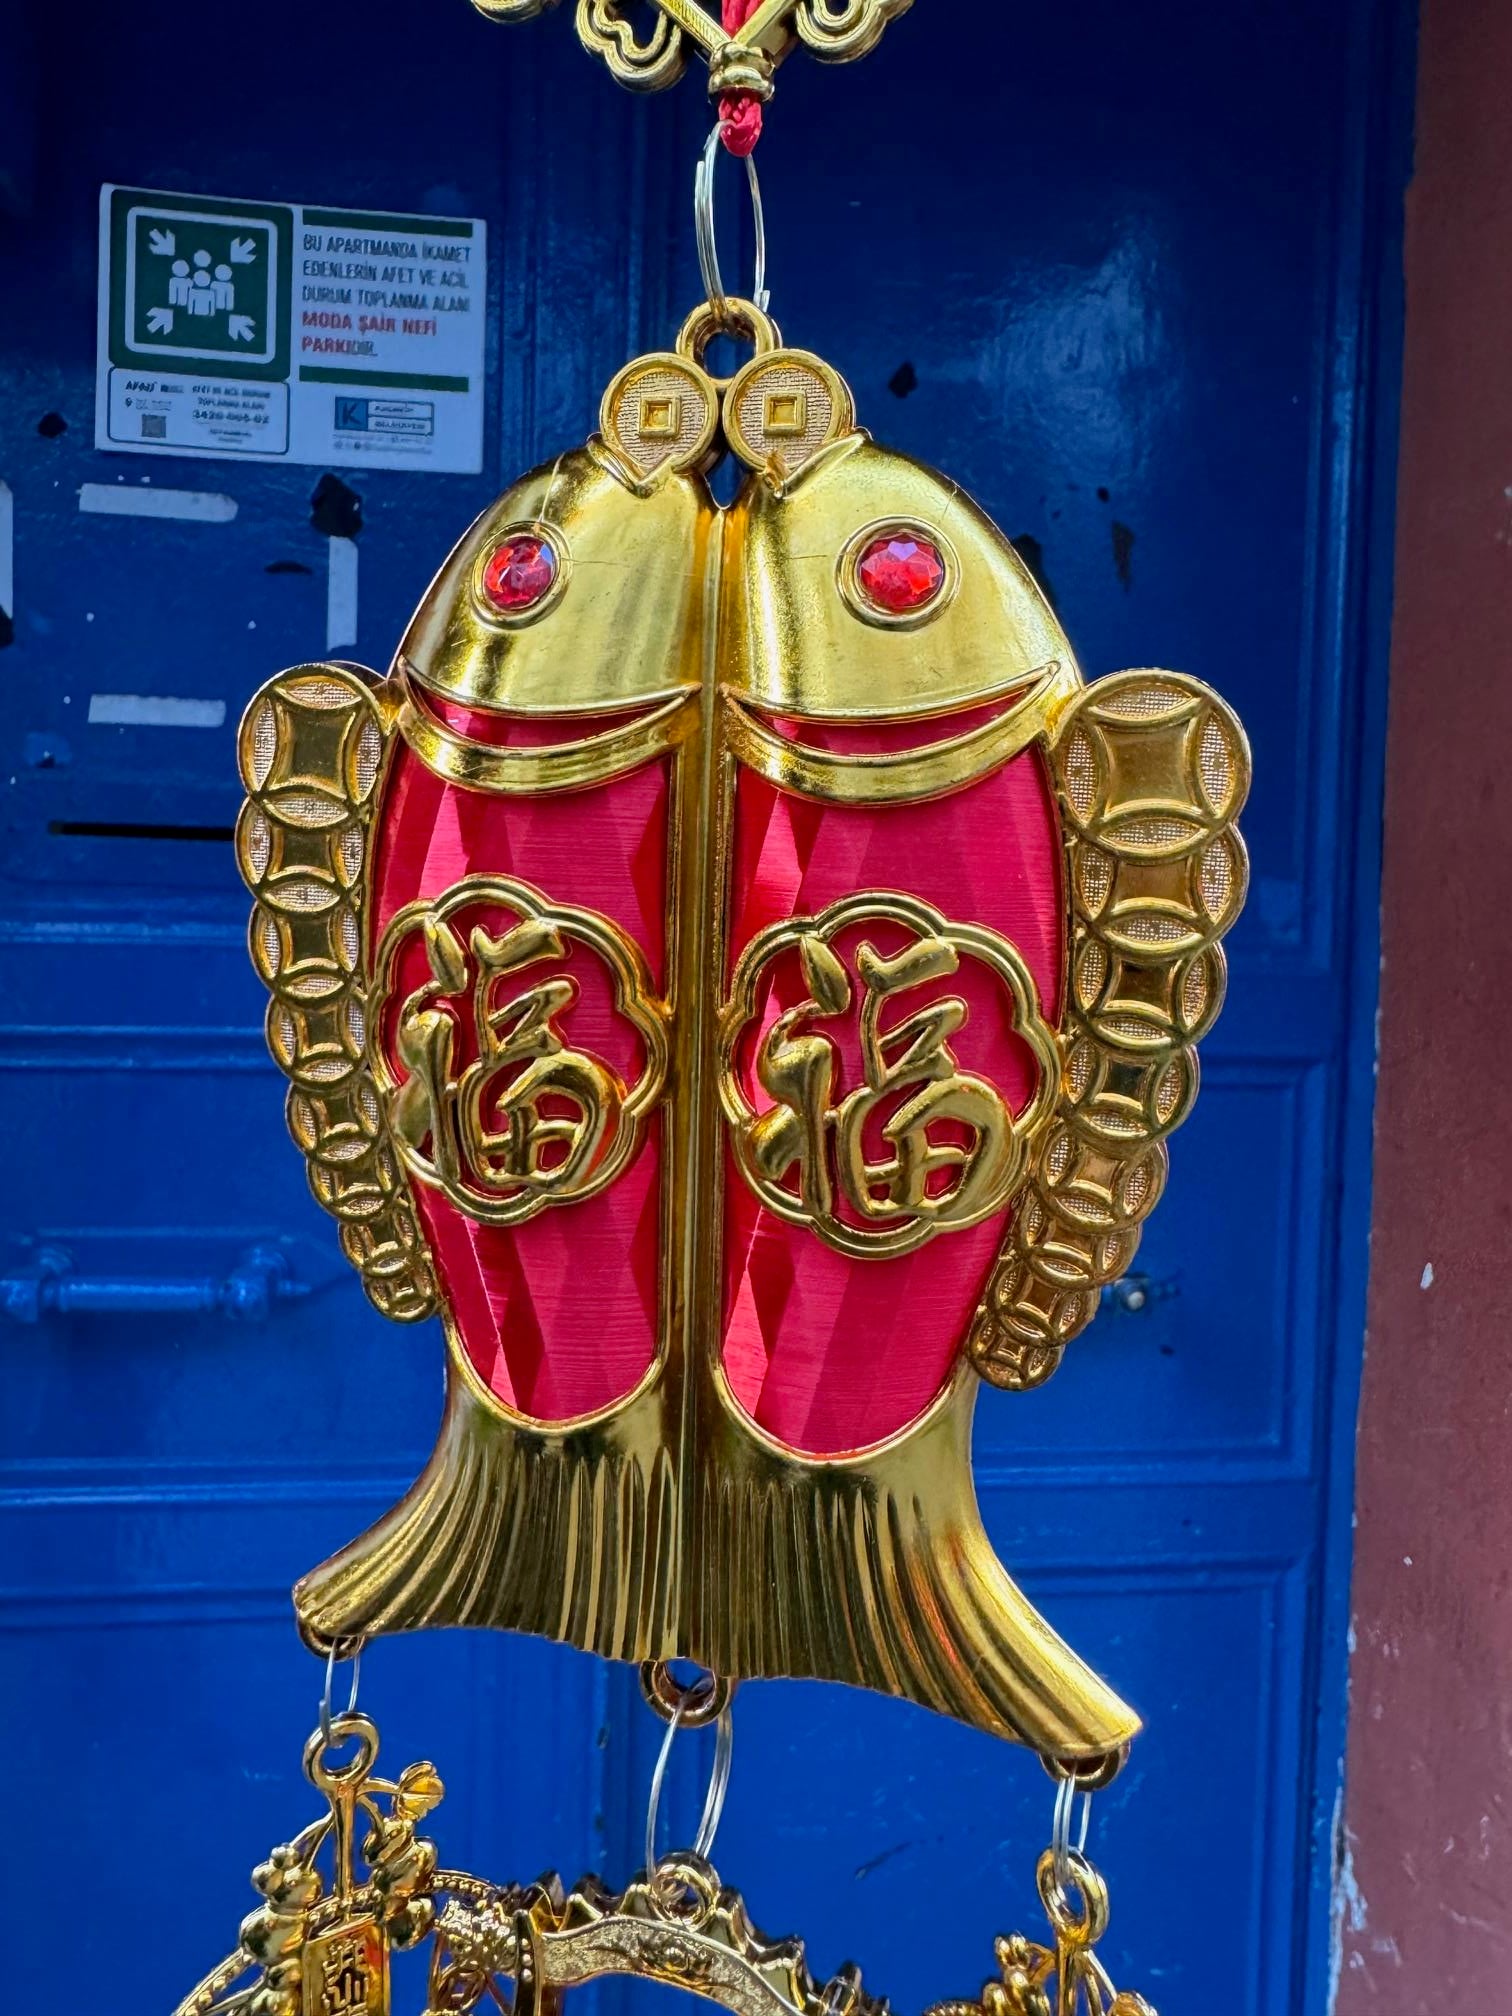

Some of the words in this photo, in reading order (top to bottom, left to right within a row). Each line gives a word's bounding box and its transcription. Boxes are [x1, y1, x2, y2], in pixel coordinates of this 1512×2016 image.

[303, 233, 322, 251] BU
[326, 236, 419, 258] APARTMANDA
[303, 259, 377, 281] EDENLERİN
[381, 266, 415, 284] AFET
[419, 268, 435, 286] VE
[302, 285, 352, 304] DURUM
[358, 288, 428, 310] TOPLANMA
[302, 311, 352, 329] MODA
[358, 313, 396, 336] ŞAİR
[402, 316, 437, 336] NEFİ
